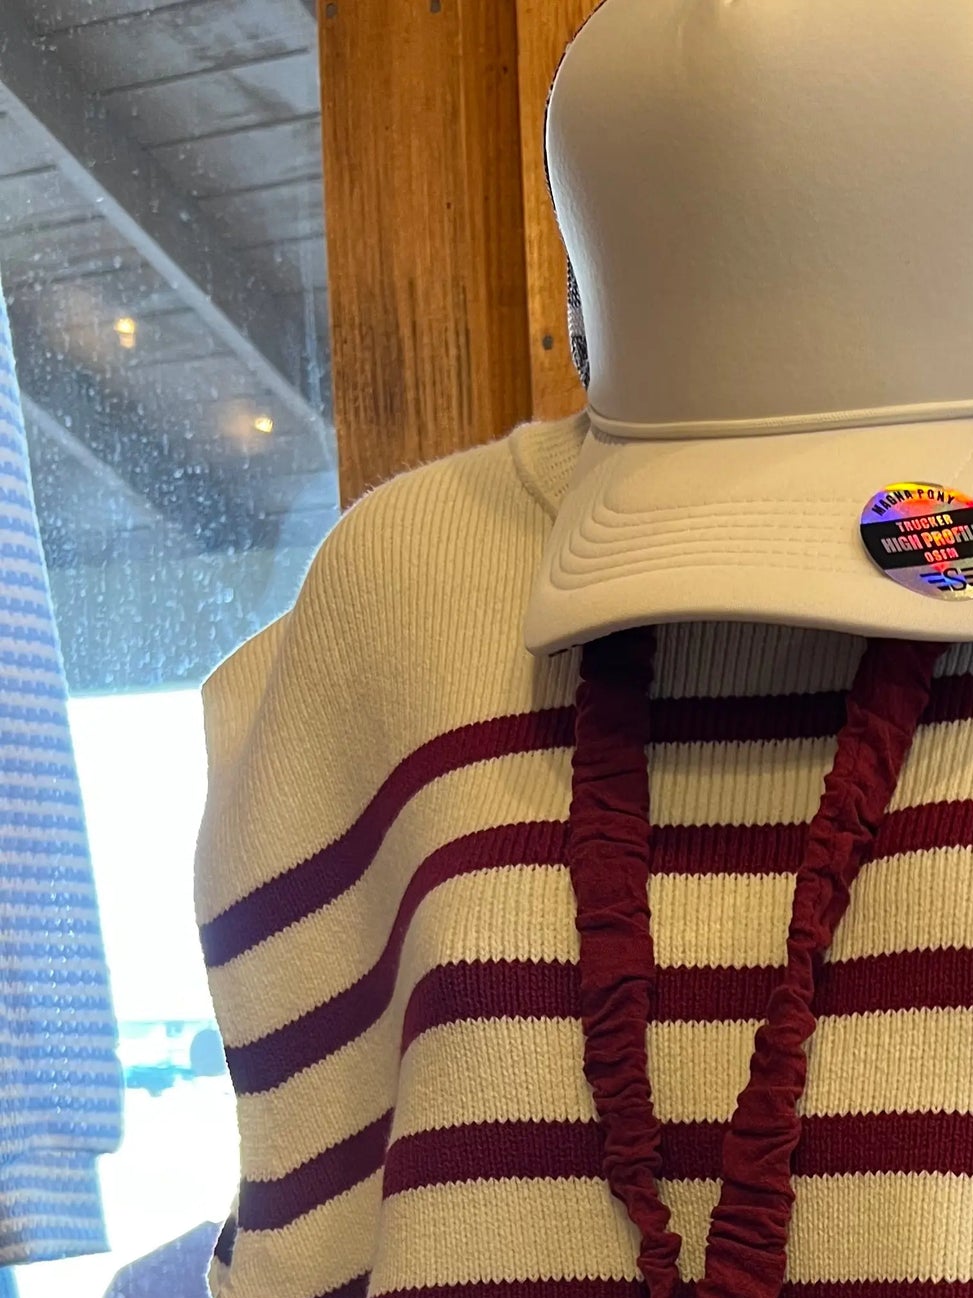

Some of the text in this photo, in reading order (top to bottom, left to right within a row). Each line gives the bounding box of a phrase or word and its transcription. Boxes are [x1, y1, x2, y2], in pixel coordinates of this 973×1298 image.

[871, 489, 913, 516] MAGNA
[896, 514, 953, 533] TRUCKER
[881, 534, 923, 554] HIGH
